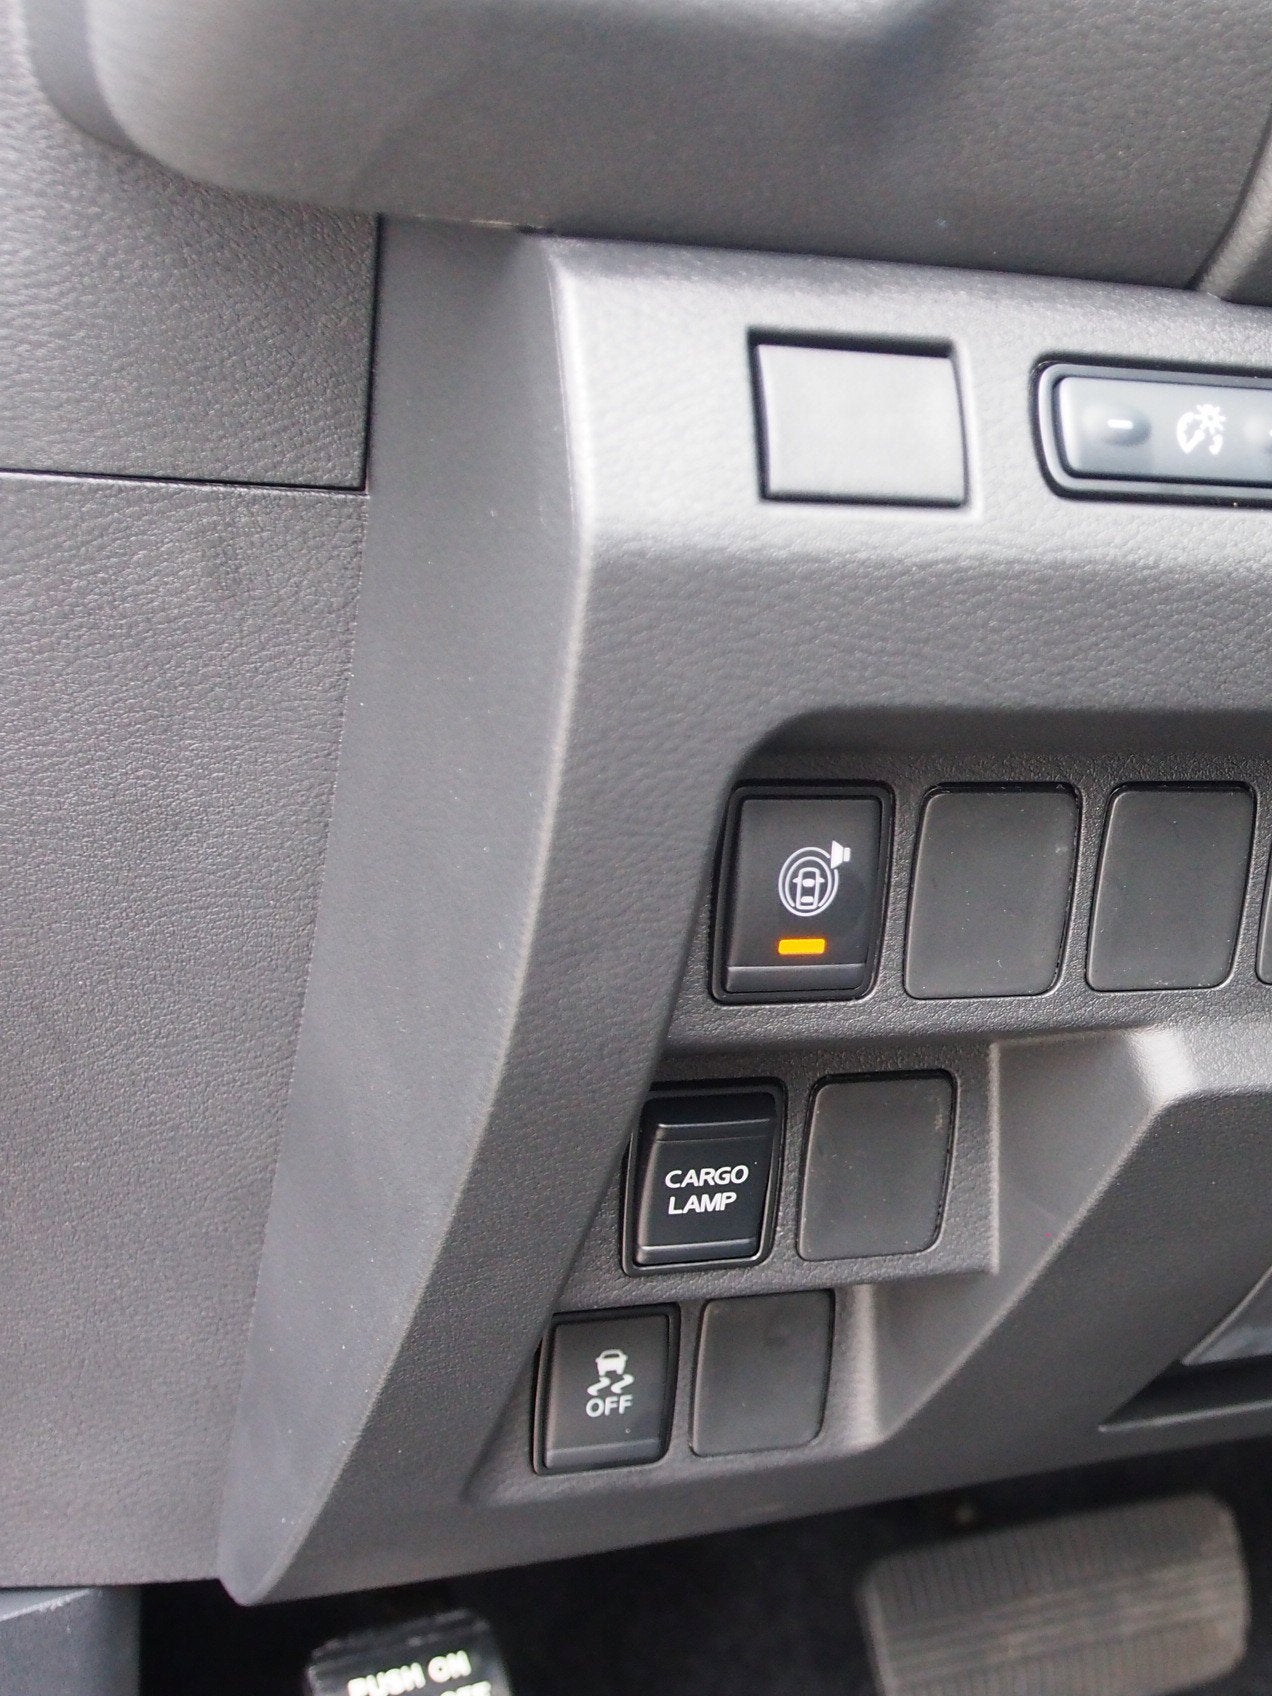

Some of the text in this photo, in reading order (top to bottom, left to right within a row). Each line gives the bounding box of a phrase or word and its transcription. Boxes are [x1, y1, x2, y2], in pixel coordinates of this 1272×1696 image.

[664, 1164, 749, 1188] CARGO
[667, 1191, 737, 1215] LAMP
[585, 1394, 634, 1417] OFF
[428, 1650, 472, 1683] ON
